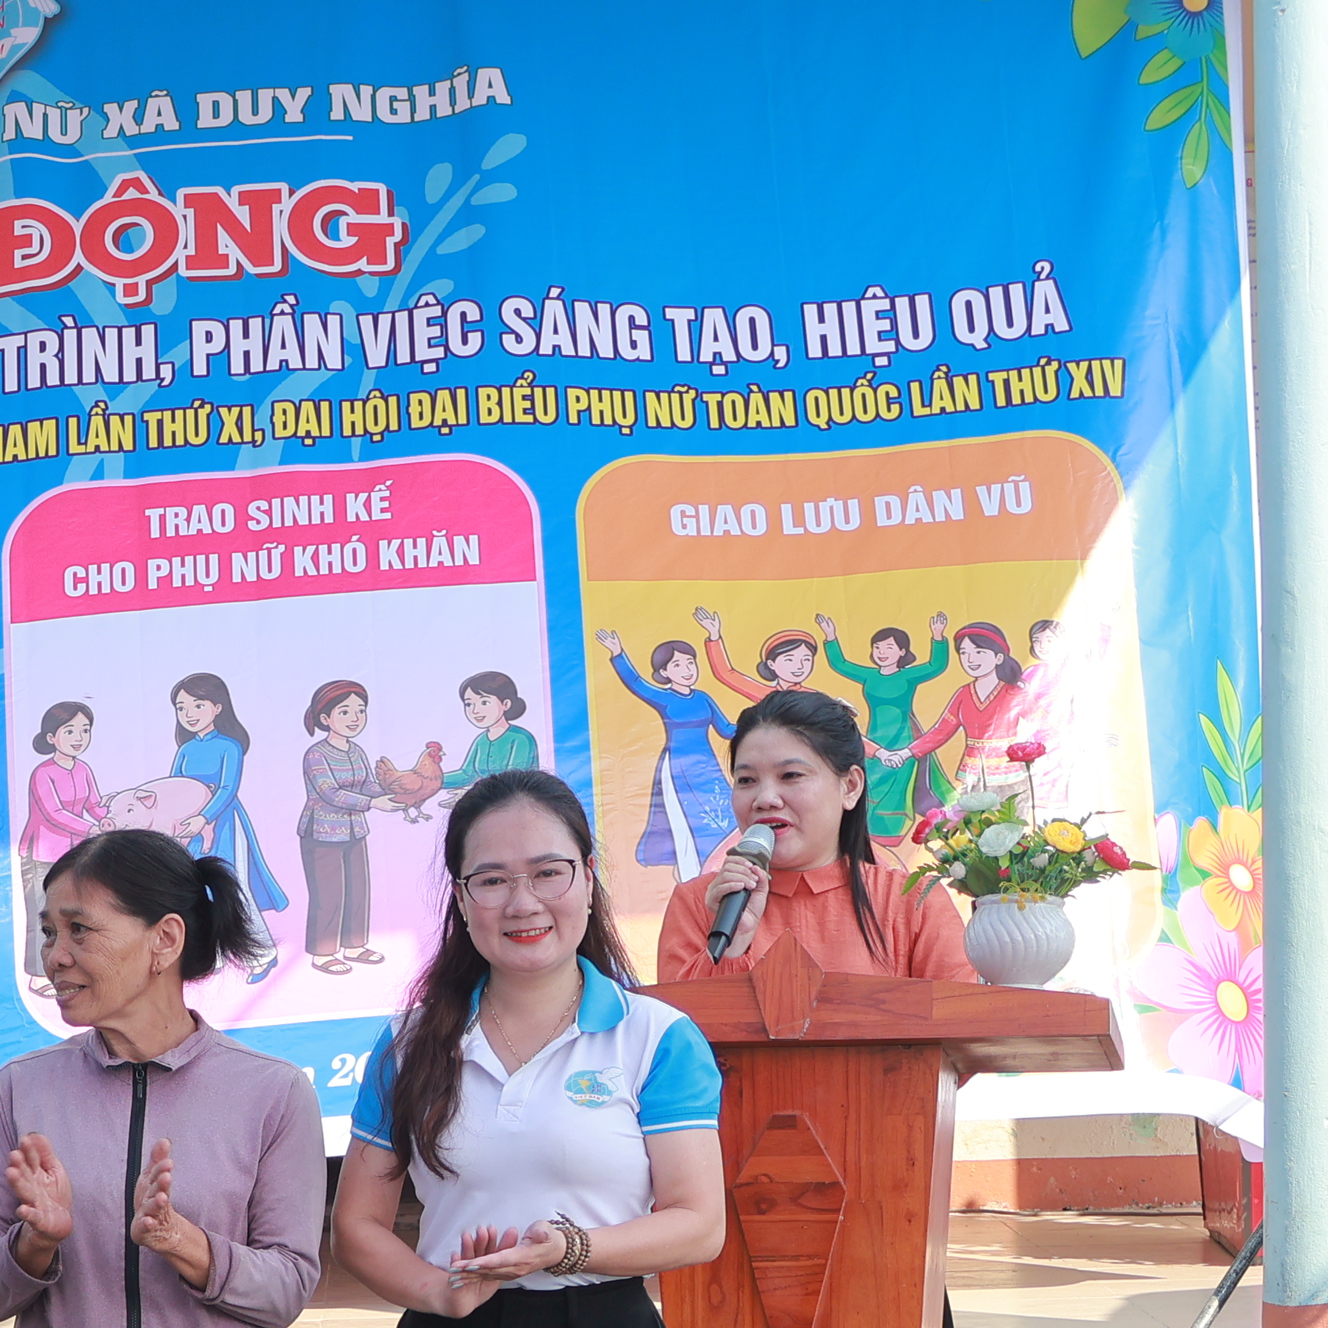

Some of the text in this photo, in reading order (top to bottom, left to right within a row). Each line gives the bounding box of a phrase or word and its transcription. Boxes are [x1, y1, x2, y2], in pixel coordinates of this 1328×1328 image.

[1, 100, 90, 144] NỮ
[103, 88, 180, 136] XÃ
[196, 83, 314, 129] DUY
[327, 66, 512, 126] NGHĨA
[191, 292, 343, 377] PHẦN
[356, 293, 483, 374] VIỆC
[499, 286, 650, 363] SÁNG
[664, 304, 789, 376] TẠO,
[801, 285, 935, 368] HIỆU
[950, 260, 1072, 350] QUẢ
[66, 399, 135, 455] LẦN
[144, 397, 213, 449] THỨ
[218, 402, 264, 447] XI,
[271, 395, 333, 445] ĐẠI
[340, 387, 399, 444] HỘI
[408, 383, 469, 434] ĐẠI
[477, 370, 557, 428] BIỂU
[567, 382, 637, 435] PHỤ
[644, 385, 698, 429] NỮ
[702, 384, 797, 430] TOÀN
[806, 371, 904, 430] QUỐC
[910, 364, 982, 418] LẦN
[988, 357, 1063, 409] THỨ
[1067, 357, 1125, 400] XIV
[145, 479, 394, 539] TRAO SINH KẾ
[669, 474, 1033, 537] GIAO LƯU DÂN VŨ
[63, 530, 480, 598] CHO PHỤ NỮ KHÓ KHĂN
